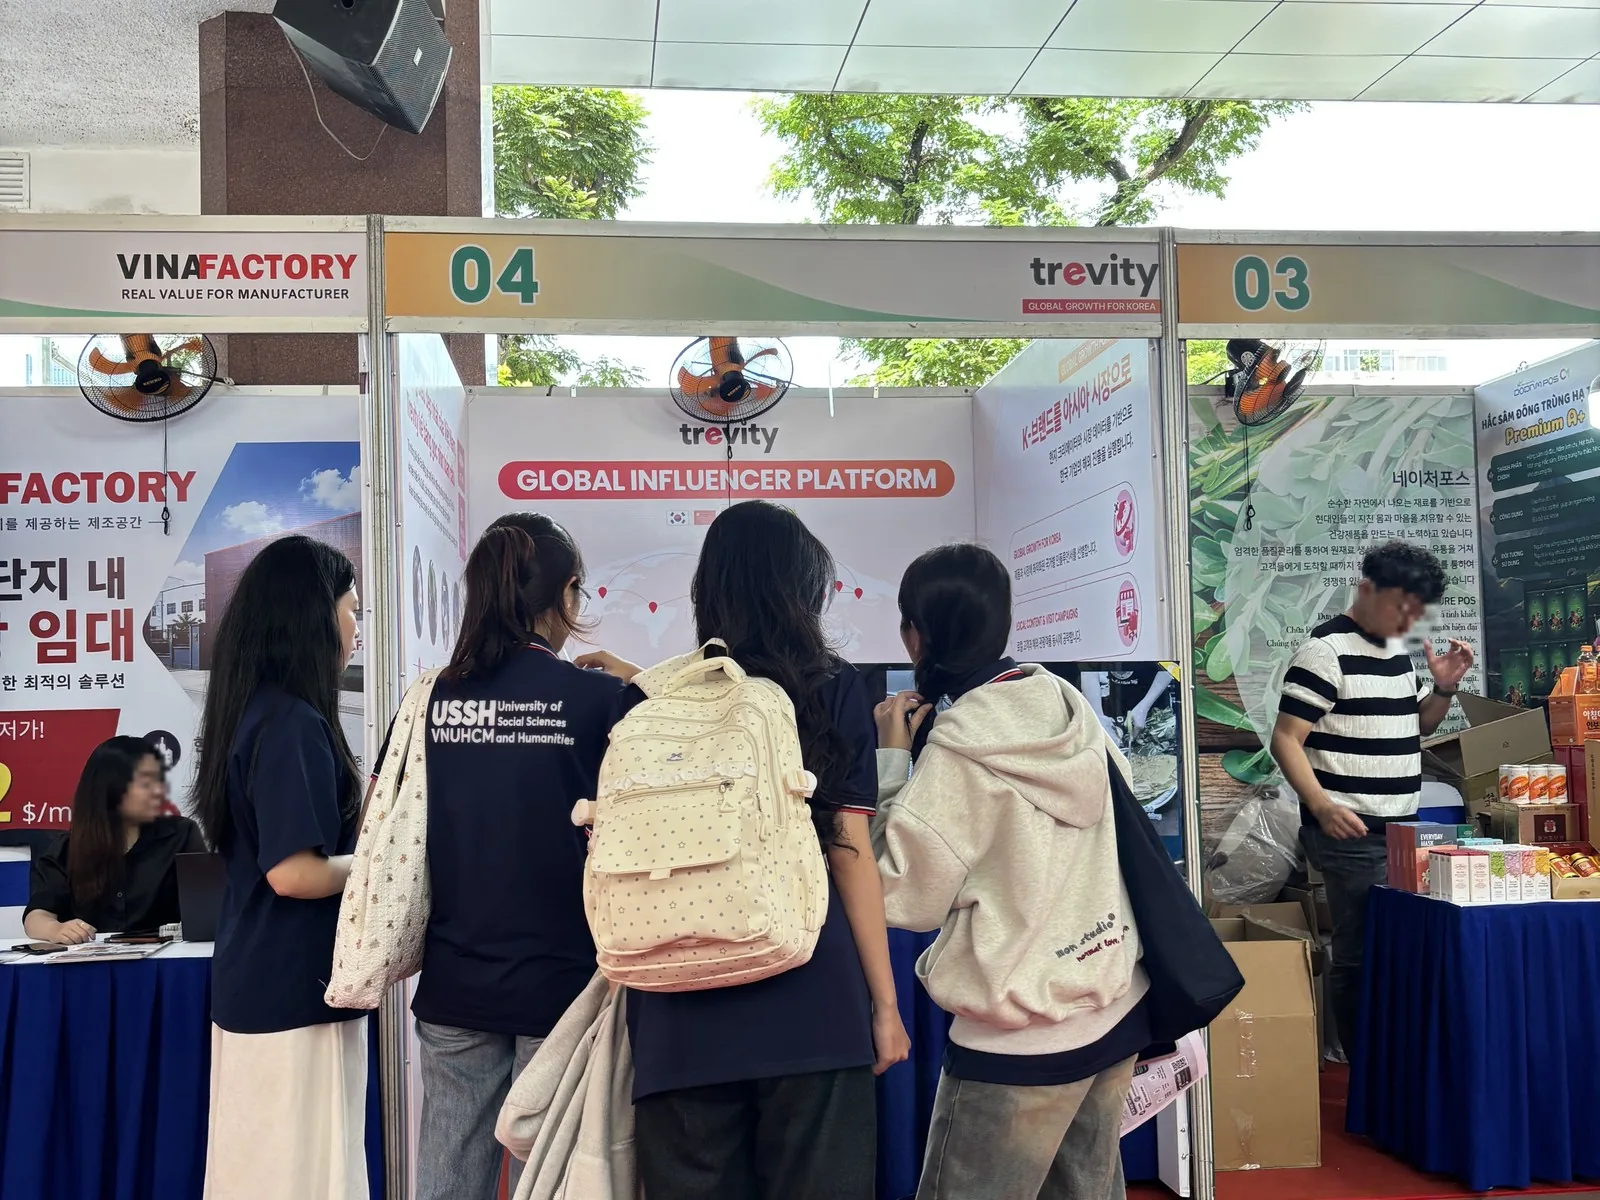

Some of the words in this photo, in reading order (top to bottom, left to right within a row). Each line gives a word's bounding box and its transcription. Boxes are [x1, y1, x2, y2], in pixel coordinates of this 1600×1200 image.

[117, 253, 357, 280] VINAFACTORY
[450, 245, 539, 304] 04
[1030, 253, 1158, 297] trevity
[1234, 256, 1311, 311] 03
[122, 289, 156, 300] REAL
[160, 289, 203, 300] VALUE
[207, 289, 234, 300] FOR
[238, 288, 349, 300] MANUFACTURER
[1028, 302, 1064, 311] GLOBAL
[1065, 302, 1106, 311] GROWTH
[1107, 302, 1125, 311] FOR
[1126, 302, 1156, 311] KOREA
[1022, 400, 1062, 451] K-브랜드를
[1063, 381, 1090, 424] 아시아
[1091, 353, 1132, 406] 시장으로
[1499, 409, 1515, 425] SÂM
[1516, 403, 1540, 420] ĐÔNG
[1540, 393, 1571, 412] TRÙNG
[1572, 387, 1585, 402] HẠ
[1505, 417, 1565, 446] Premium
[1566, 408, 1586, 428] A+
[678, 421, 779, 454] trevity
[516, 469, 626, 492] GLOBAL
[630, 469, 791, 491] INFLUENCER
[797, 467, 937, 490] PLATFORM
[1392, 470, 1471, 487] 네이처포스
[0, 471, 197, 504] FACTORY
[1327, 499, 1351, 508] 순수한
[1353, 499, 1386, 508] 자연에서
[1388, 498, 1413, 508] 나오는
[1413, 498, 1438, 508] 재료를
[1440, 498, 1472, 507] 기반으로
[25, 517, 80, 531] 제공하는
[88, 516, 142, 530] 제조공간
[1315, 514, 1356, 524] 현대인들의
[1394, 514, 1418, 523] 마음을
[1420, 514, 1444, 523] 치유할
[1445, 513, 1454, 523] 수
[1455, 513, 1472, 523] 있는
[1328, 530, 1369, 540] 건강제품을
[1370, 529, 1395, 539] 만드는
[1407, 529, 1439, 539] 노력하고
[1441, 528, 1473, 538] 있습니다
[1234, 546, 1259, 556] 엄격한
[1261, 546, 1302, 556] 품질관리를
[1304, 546, 1329, 556] 통하여
[1331, 546, 1355, 555] 원재료
[1432, 544, 1456, 554] 유통을
[1260, 562, 1301, 572] 고객들에게
[1303, 561, 1328, 571] 도착할
[1330, 561, 1354, 571] 때까지
[1450, 560, 1474, 570] 통하여
[87, 556, 126, 600] 내
[1323, 577, 1347, 587] 경쟁력
[1458, 596, 1476, 605] POS
[28, 608, 134, 665] 임대
[24, 674, 71, 690] 최적의
[78, 672, 125, 689] 솔루션
[431, 700, 497, 727] USSH
[497, 700, 548, 713] University
[550, 700, 563, 712] of
[497, 716, 525, 727] Social
[526, 716, 567, 728] Sciences
[431, 728, 495, 743] VNUHCM
[495, 731, 515, 743] and
[517, 732, 575, 746] Humanities
[1080, 920, 1114, 945] studio
